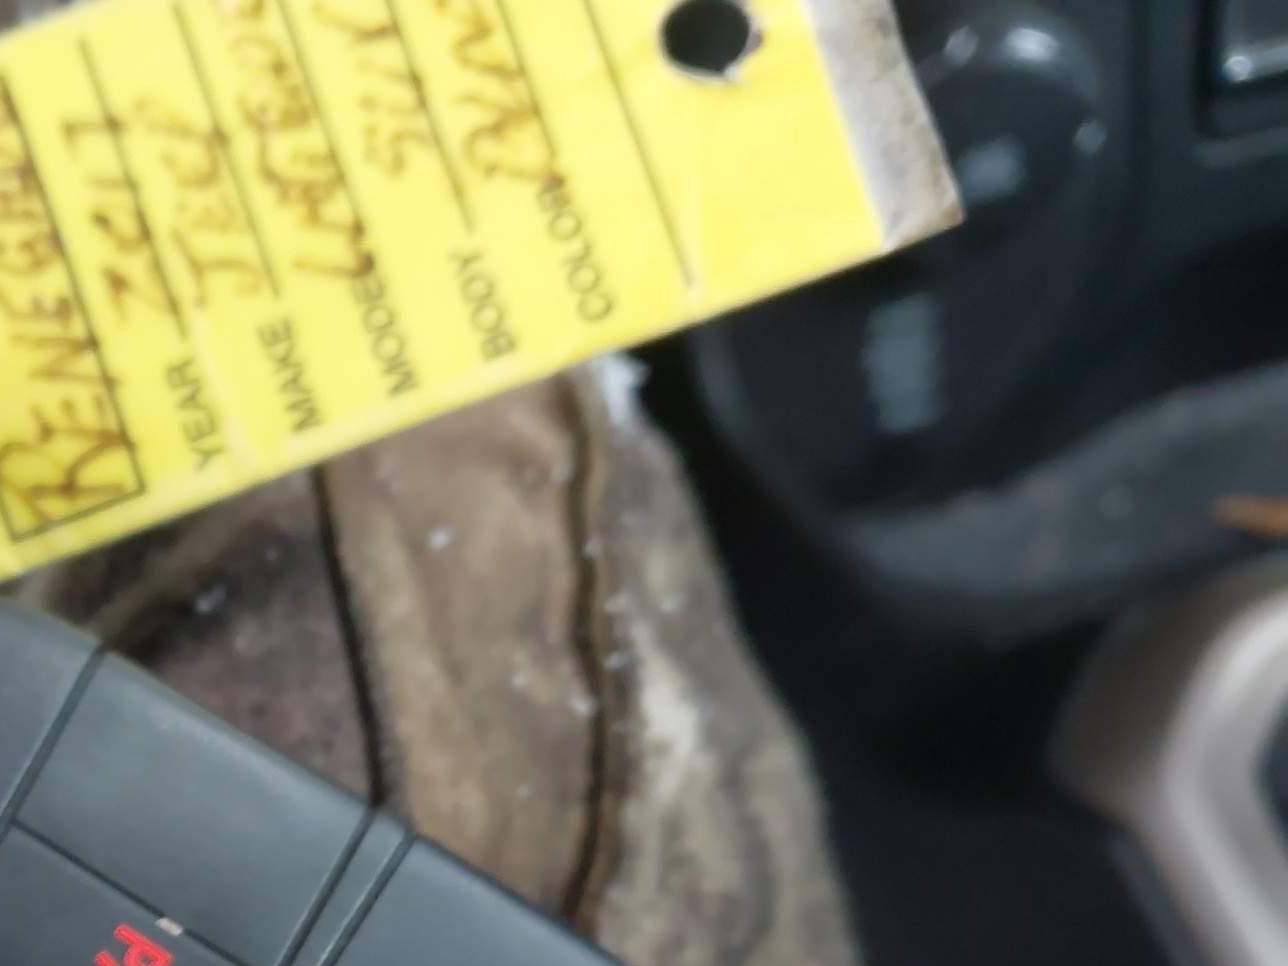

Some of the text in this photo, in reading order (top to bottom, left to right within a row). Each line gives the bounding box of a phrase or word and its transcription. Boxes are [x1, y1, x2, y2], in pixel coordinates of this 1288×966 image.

[450, 248, 516, 362] BODY
[167, 357, 223, 471] YEAR
[254, 316, 324, 436] MAKE
